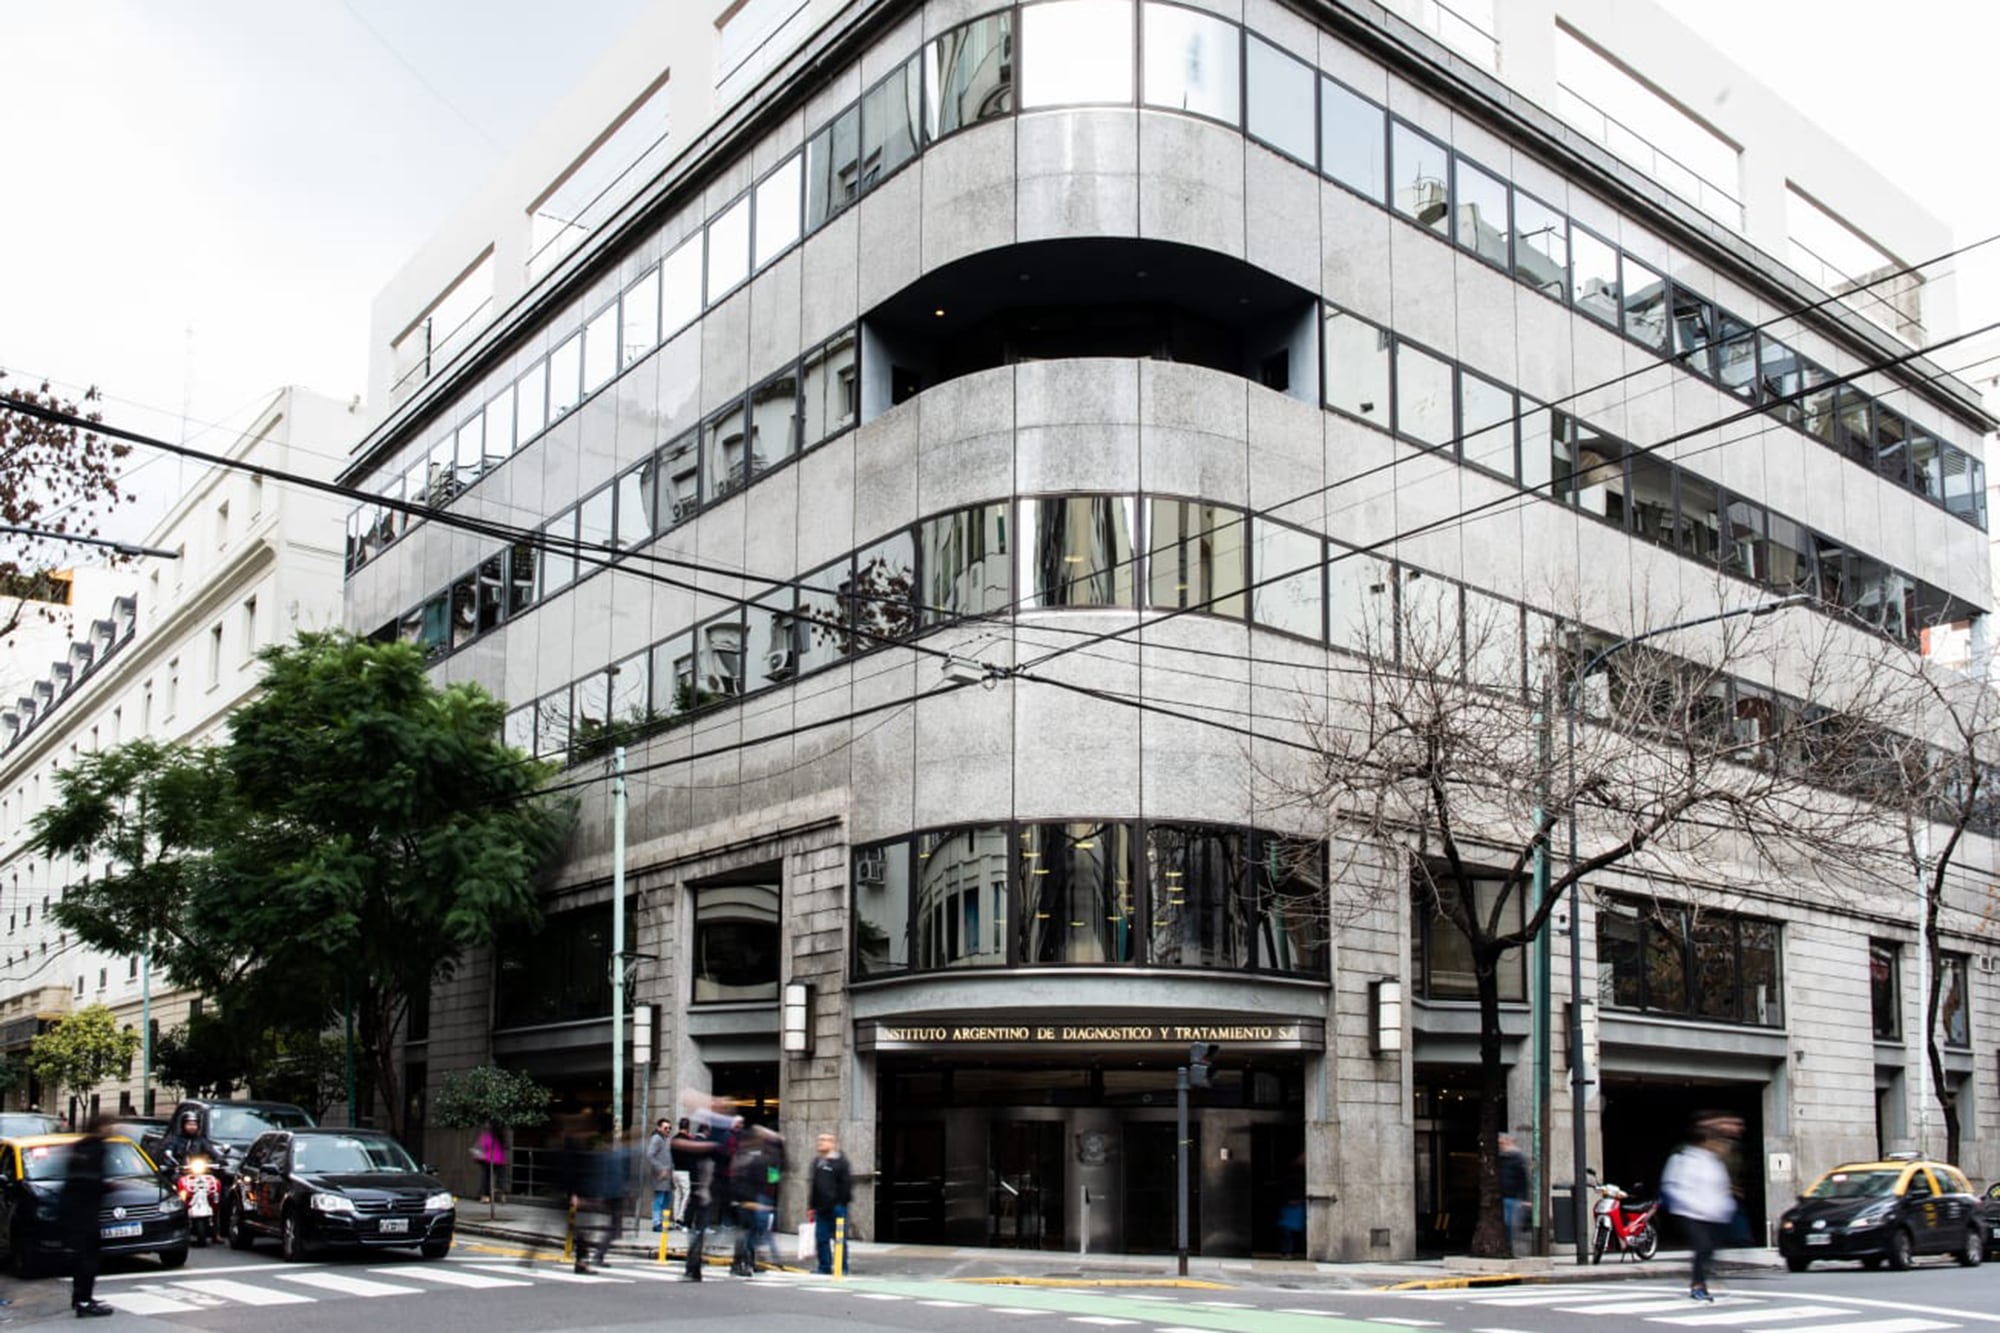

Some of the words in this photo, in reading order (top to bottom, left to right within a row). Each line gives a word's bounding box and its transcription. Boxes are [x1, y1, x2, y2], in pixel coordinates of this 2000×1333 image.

[953, 1027, 1029, 1040] ARGENTINO
[1037, 1027, 1055, 1040] DE
[1063, 1027, 1152, 1040] DIAGNOSTICO
[1159, 1027, 1169, 1040] Y
[1174, 1027, 1272, 1040] TRATAMIENTO
